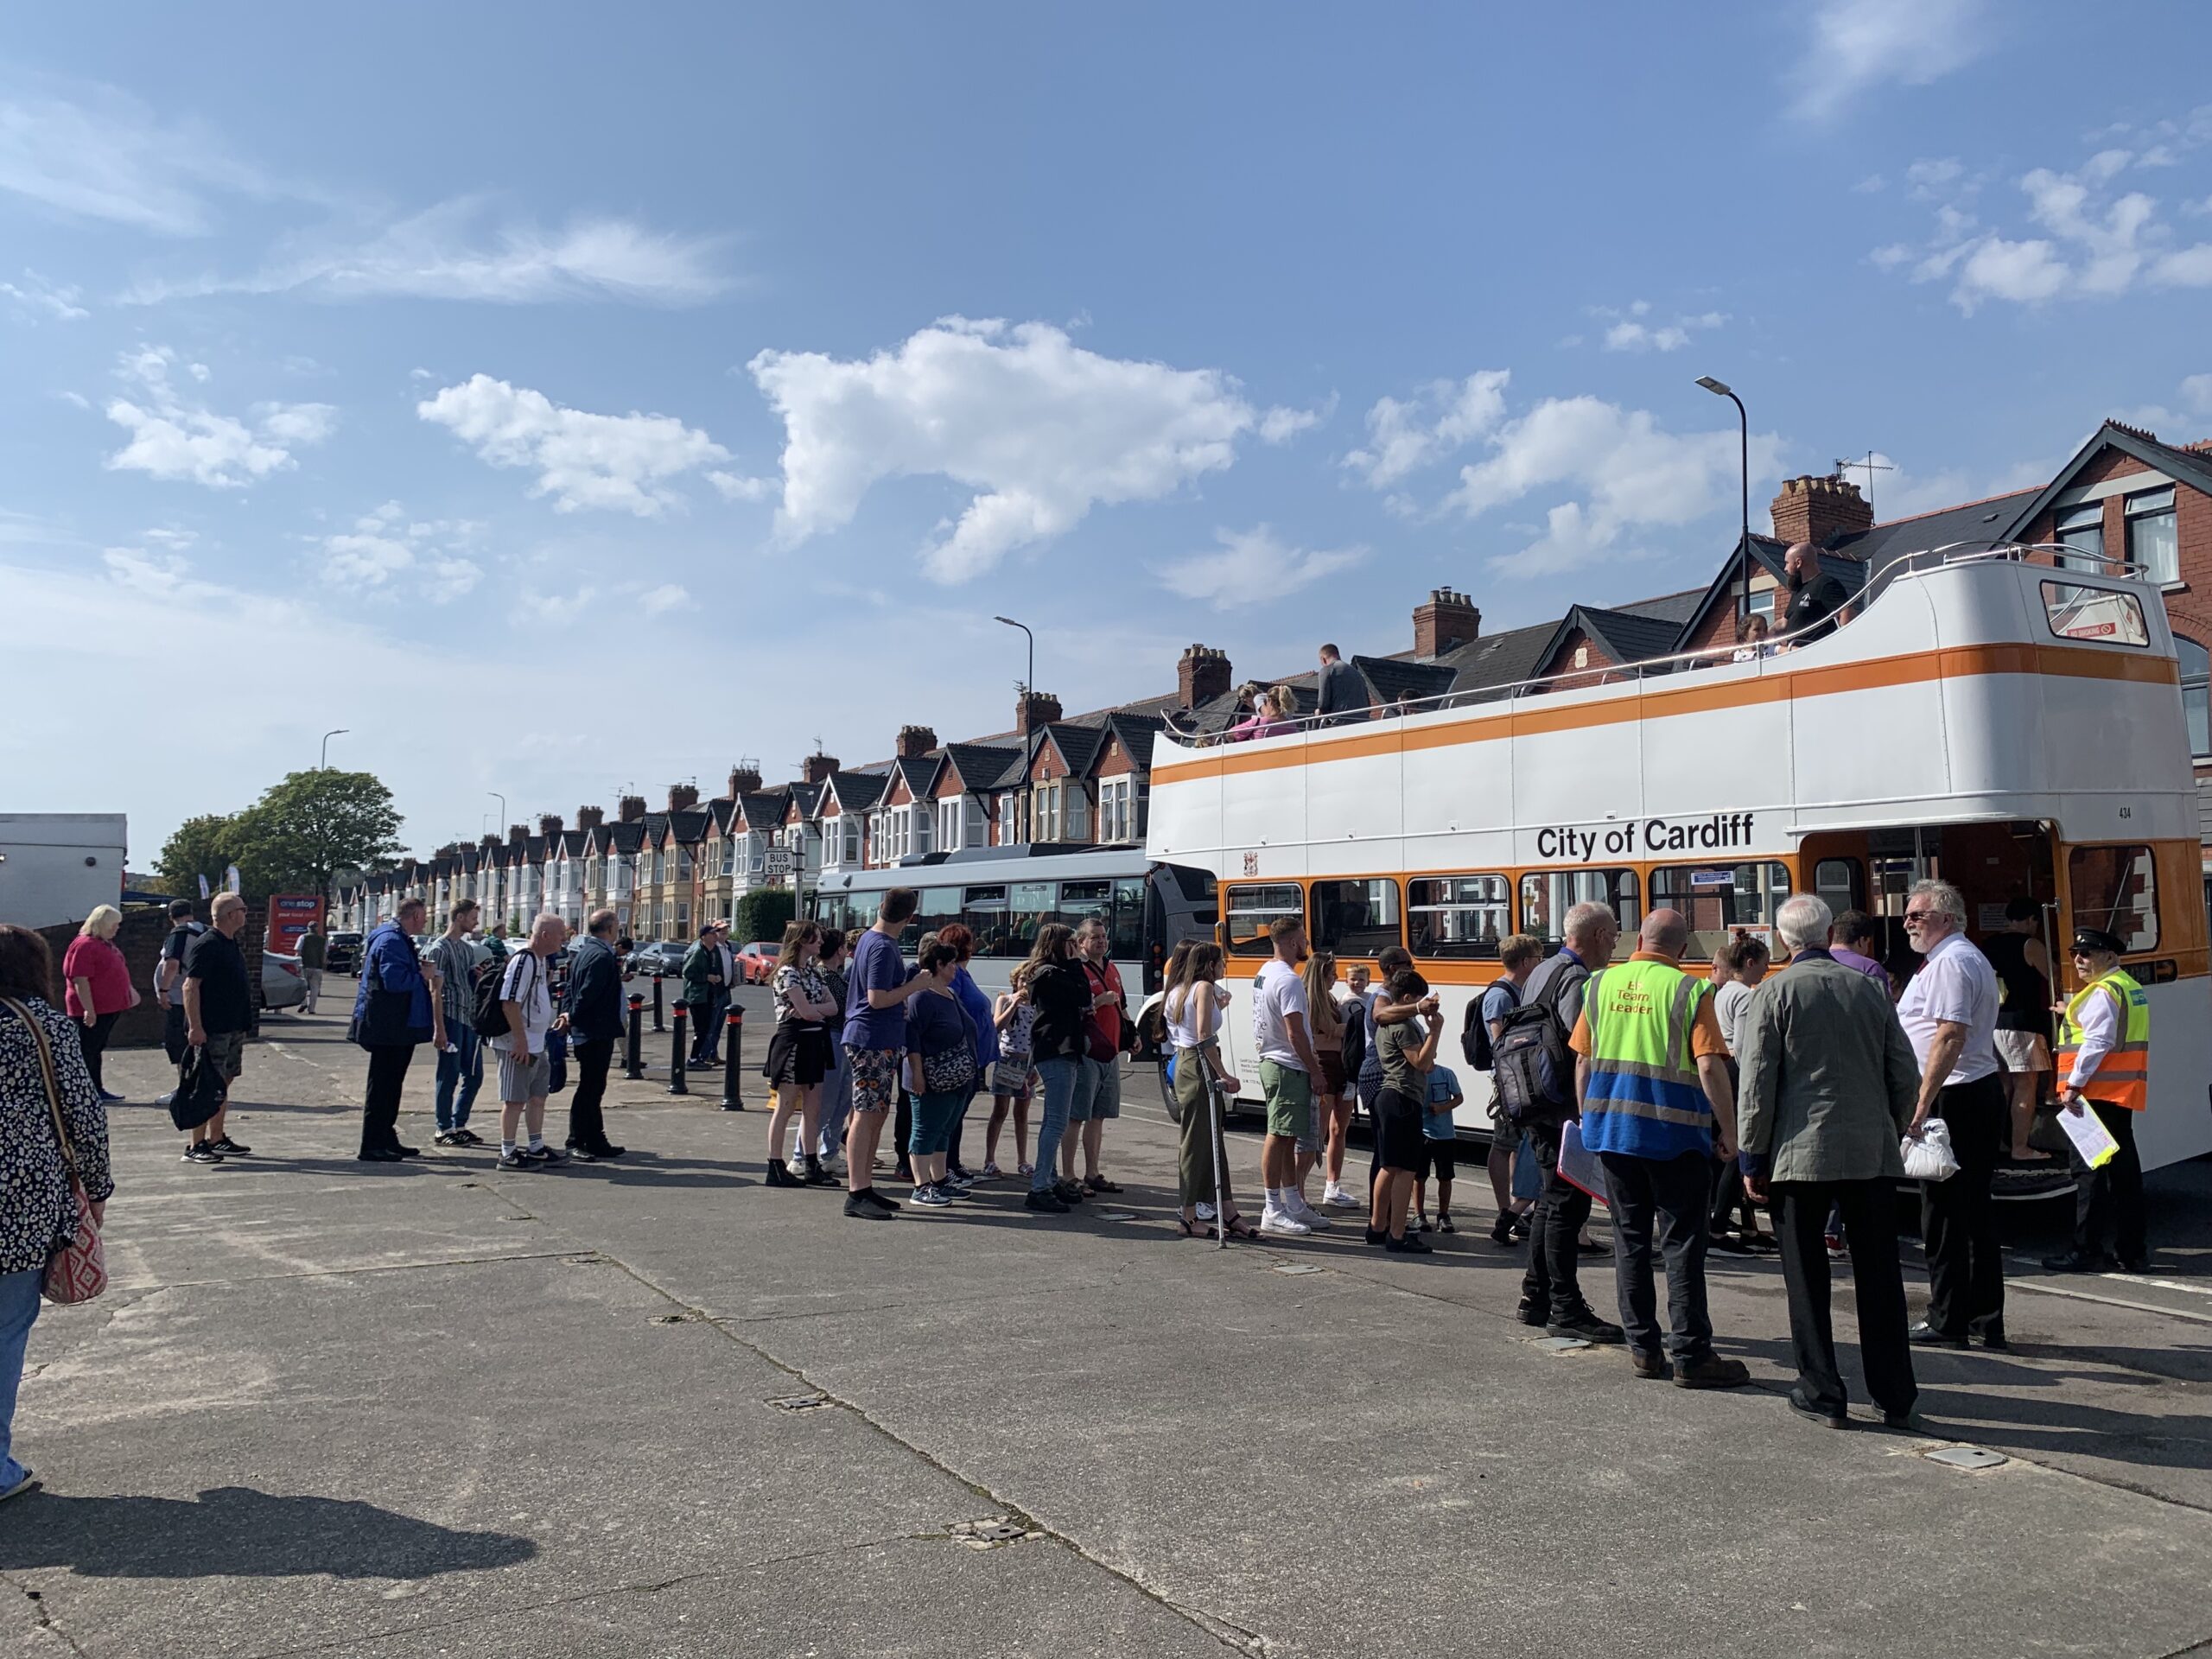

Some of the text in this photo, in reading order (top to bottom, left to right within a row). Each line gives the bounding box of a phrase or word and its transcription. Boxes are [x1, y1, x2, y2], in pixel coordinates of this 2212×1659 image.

[2120, 807, 2131, 819] 434
[1537, 813, 1753, 862] City of Cardiff
[770, 853, 788, 862] BUS
[768, 864, 791, 874] STOP
[296, 900, 315, 909] stop
[1617, 989, 1649, 1002] Team
[1610, 1001, 1653, 1015] Leader
